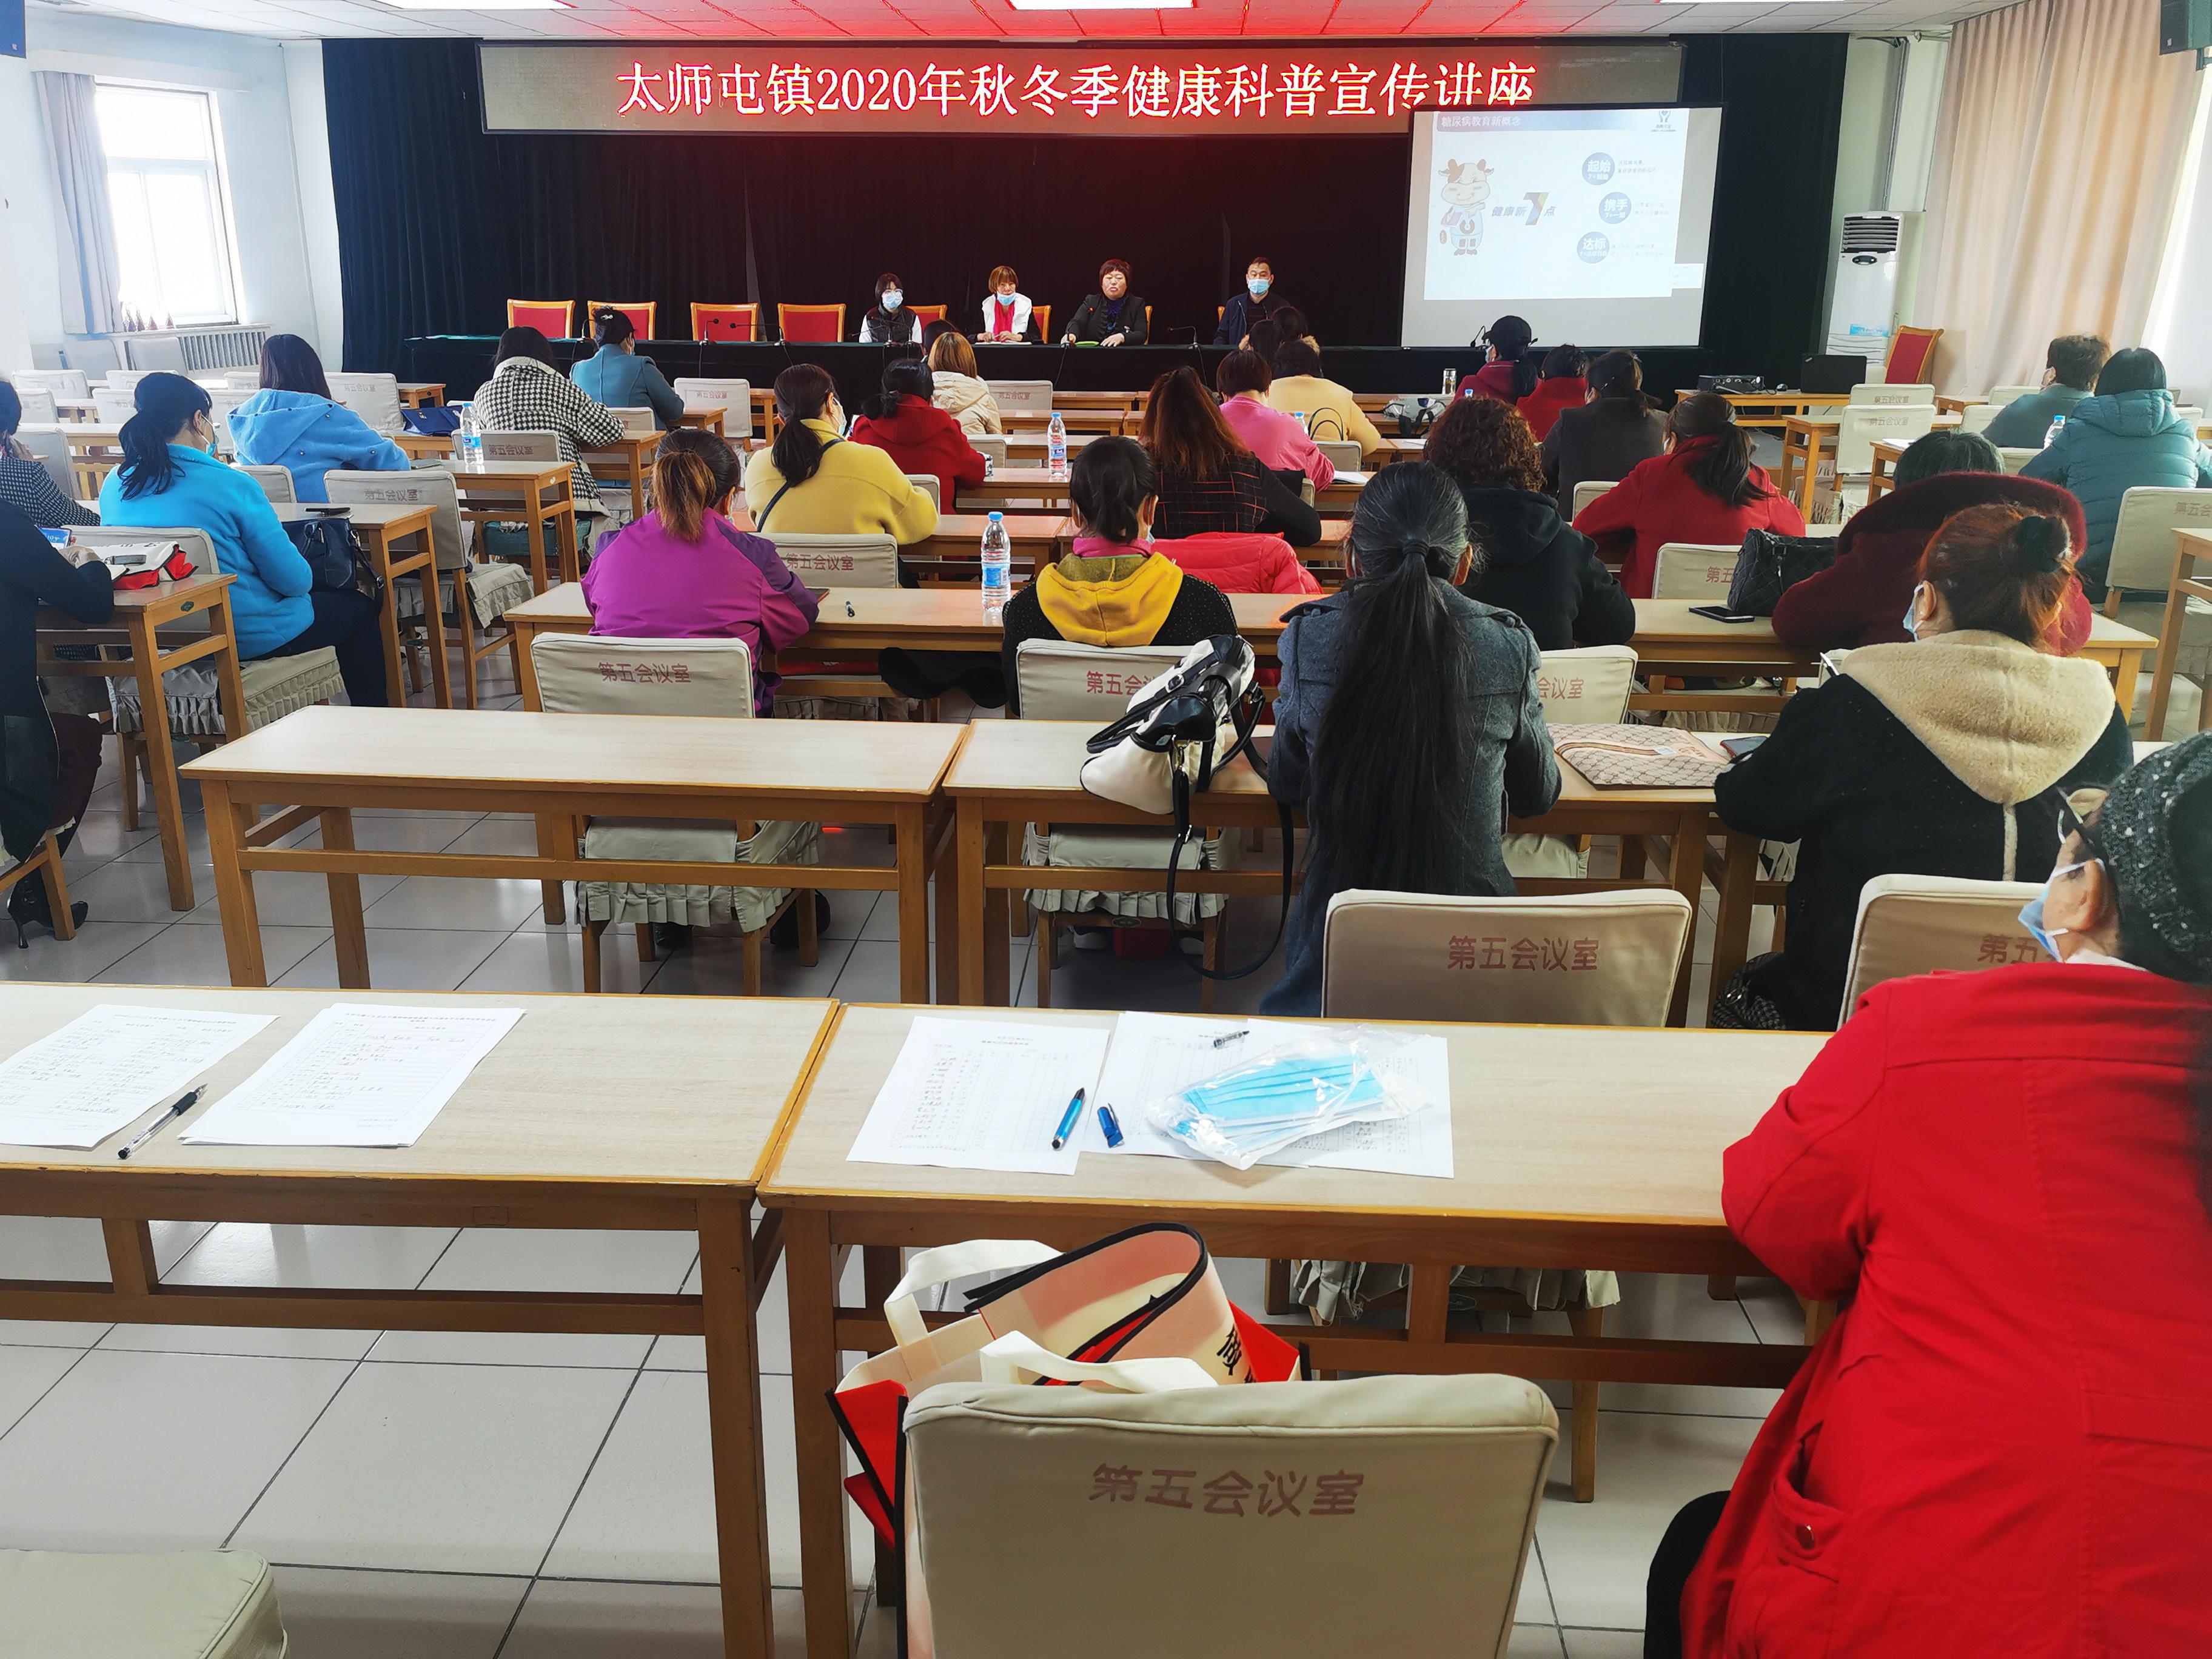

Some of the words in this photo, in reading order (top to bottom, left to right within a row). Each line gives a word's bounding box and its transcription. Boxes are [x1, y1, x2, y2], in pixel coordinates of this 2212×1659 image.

[617, 62, 1537, 117] 太师屯镇2020年秋冬季健康科普宣传讲座
[1441, 116, 1521, 127] 糖尿病教育新概念
[1583, 238, 1606, 250] 达标
[786, 553, 854, 571] 第五会议室
[598, 662, 691, 683] 第五会议室
[1537, 676, 1584, 700] 会议室
[1447, 935, 1599, 971] 第五会议室
[1977, 933, 2057, 964] 第五
[1089, 1463, 1364, 1517] 第五会议室
